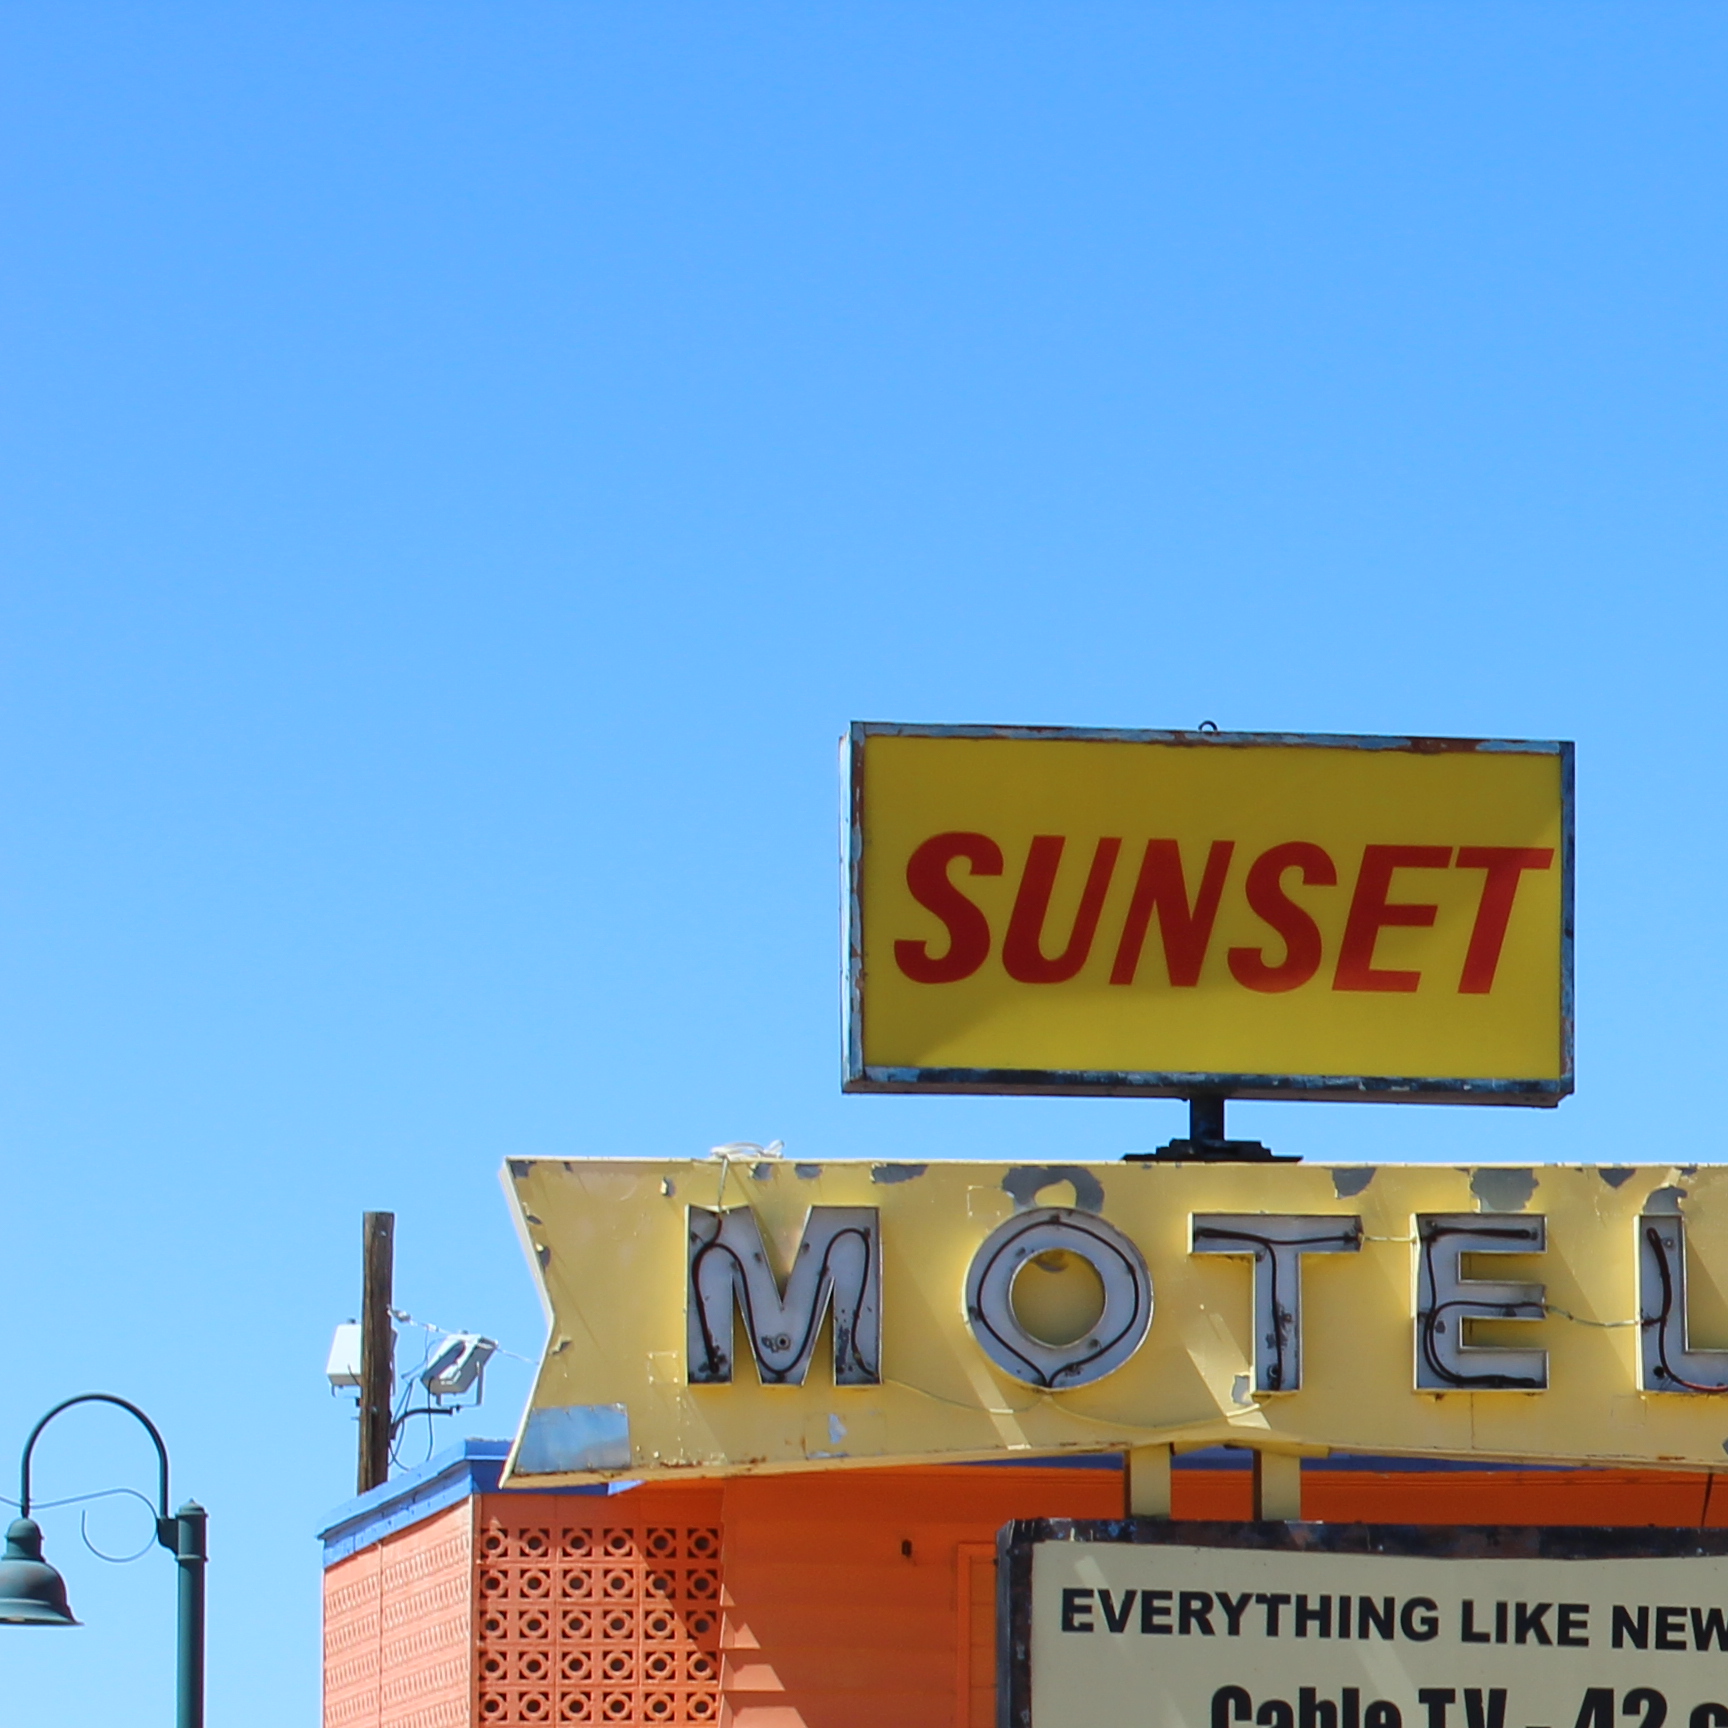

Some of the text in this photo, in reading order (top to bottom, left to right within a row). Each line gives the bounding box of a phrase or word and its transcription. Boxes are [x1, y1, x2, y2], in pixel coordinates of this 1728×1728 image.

[894, 831, 1555, 994] SUNSET
[1061, 1588, 1440, 1643] EVERYTHING
[1460, 1599, 1591, 1649] LIKE
